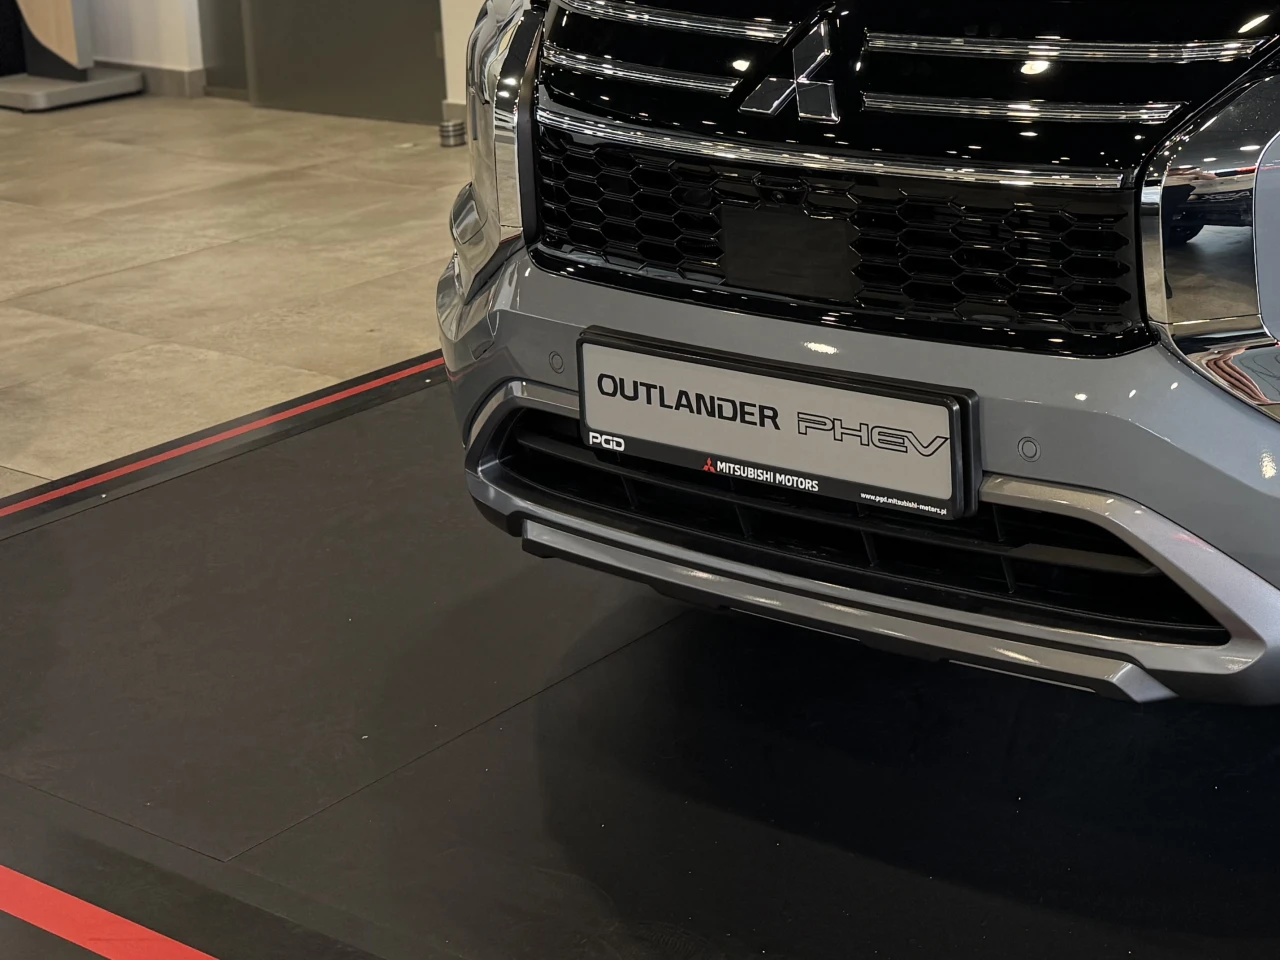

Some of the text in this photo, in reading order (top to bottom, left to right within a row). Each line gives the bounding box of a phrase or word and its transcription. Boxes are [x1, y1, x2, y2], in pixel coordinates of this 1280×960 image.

[596, 372, 951, 458] OUTLANDER PHEV
[588, 431, 626, 452] PGD
[716, 460, 820, 493] MITSUBISHI MOTORS
